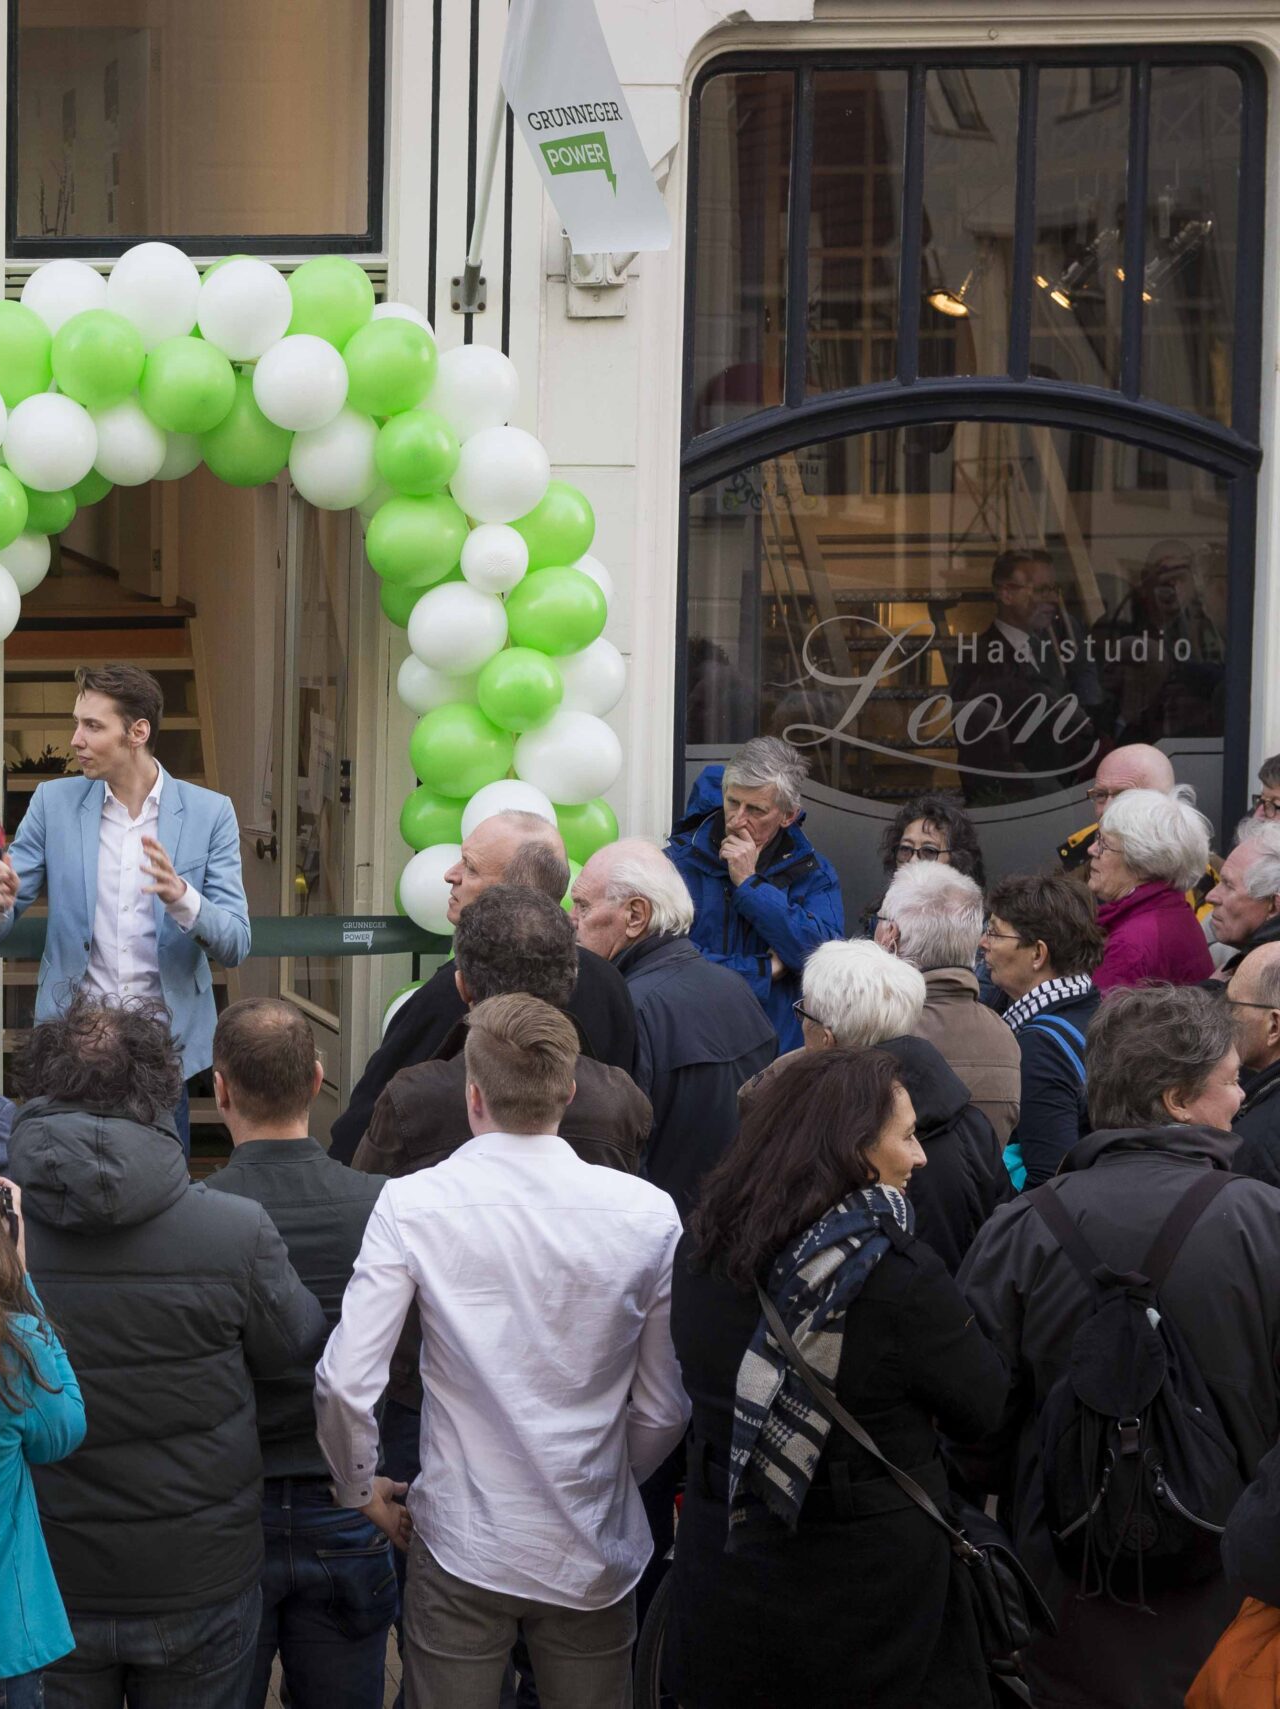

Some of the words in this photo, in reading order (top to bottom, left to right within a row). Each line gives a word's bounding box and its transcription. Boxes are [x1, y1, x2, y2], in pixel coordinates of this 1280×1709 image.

[527, 101, 623, 131] GRUNNEGER
[546, 143, 607, 168] POWER
[956, 630, 1193, 664] Haarstudio
[782, 615, 1100, 779] Leon
[343, 921, 387, 929] GRUNNEGER
[344, 933, 370, 941] POWER
